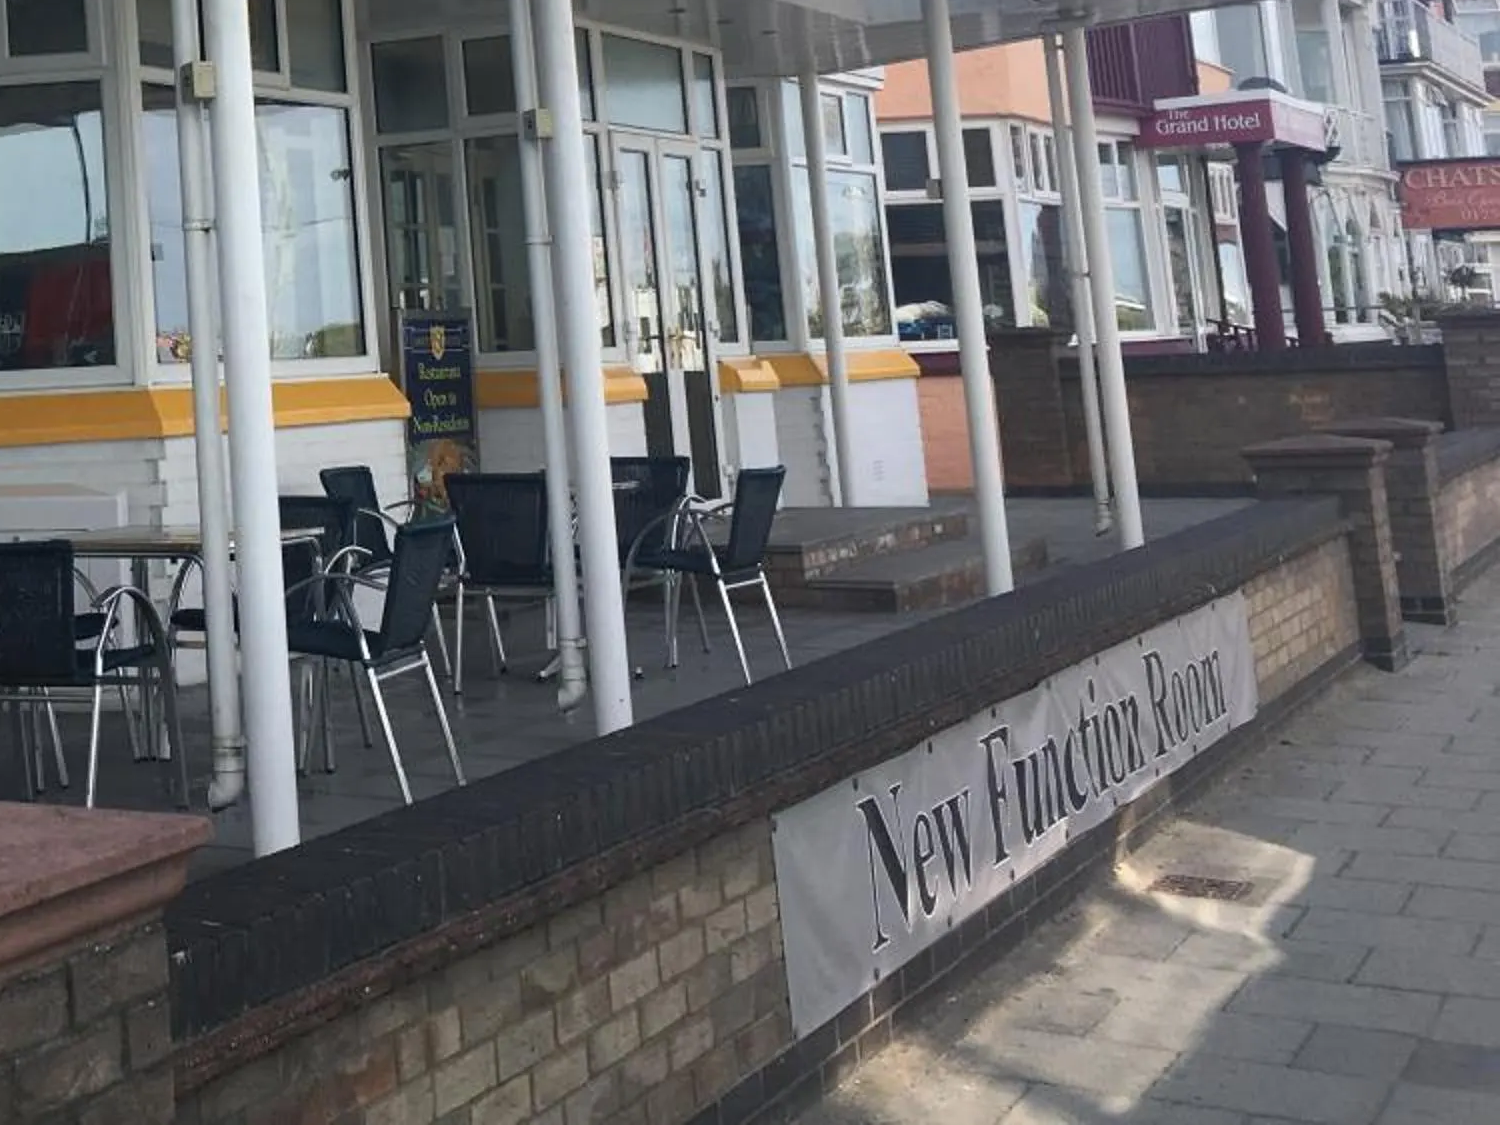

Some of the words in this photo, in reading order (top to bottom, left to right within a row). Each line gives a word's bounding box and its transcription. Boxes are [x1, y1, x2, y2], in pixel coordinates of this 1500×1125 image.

[1156, 116, 1209, 135] Grand
[1214, 112, 1261, 132] Hotel
[1168, 110, 1190, 120] The
[856, 779, 973, 955] New
[980, 679, 1146, 868] Function
[1141, 647, 1227, 758] Room
